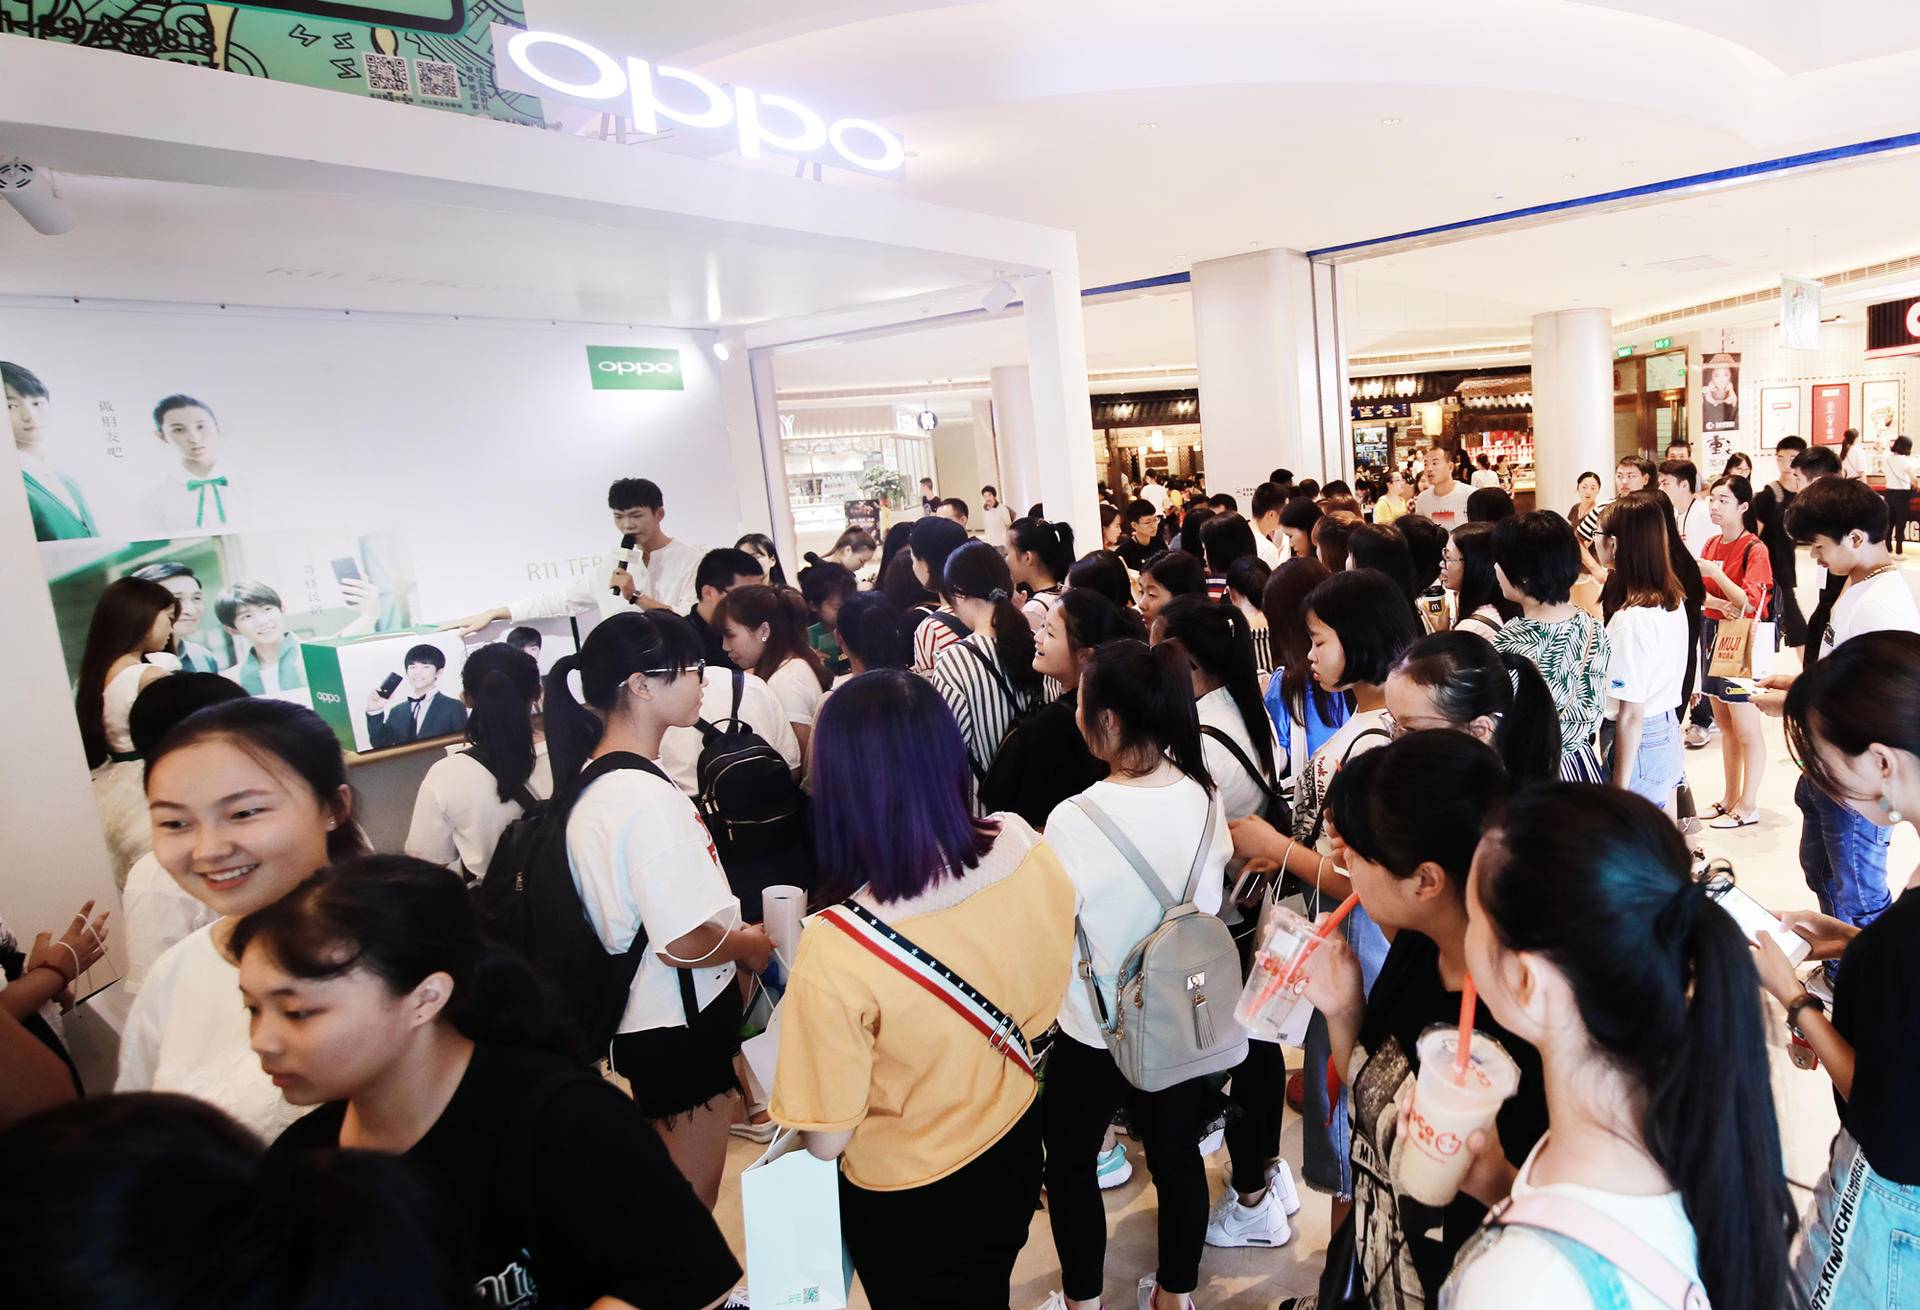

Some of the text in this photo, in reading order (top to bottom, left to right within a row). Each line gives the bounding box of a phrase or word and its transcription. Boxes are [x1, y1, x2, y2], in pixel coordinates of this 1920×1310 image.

[508, 31, 905, 171] oppo
[598, 361, 674, 375] oppo
[1718, 637, 1742, 651] MUJI
[316, 691, 341, 704] oppo
